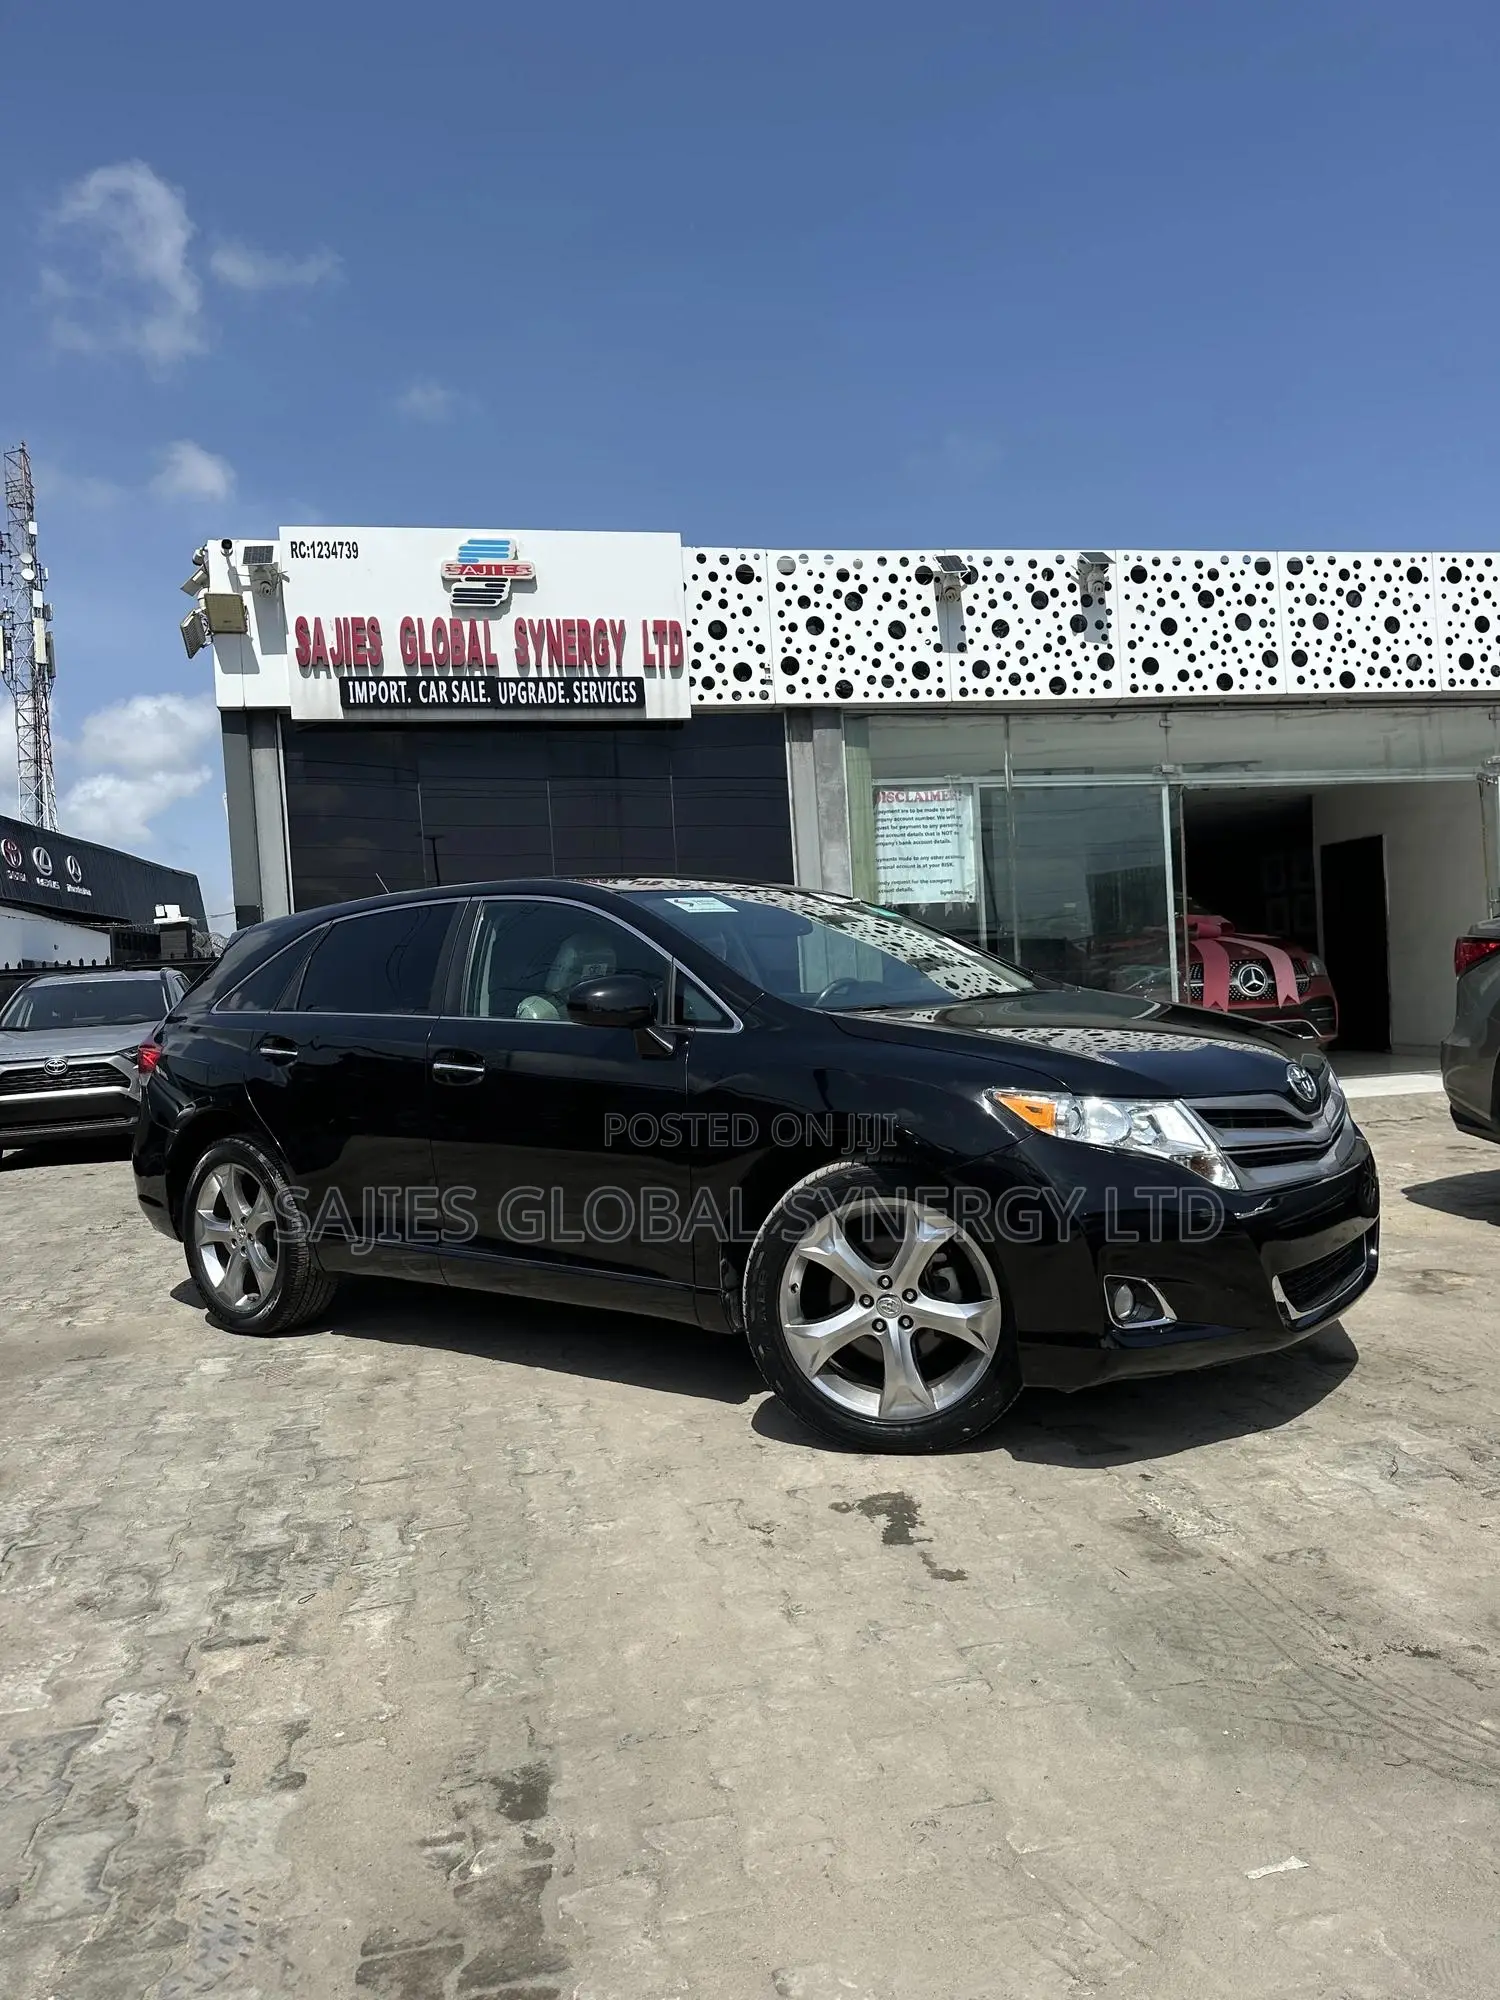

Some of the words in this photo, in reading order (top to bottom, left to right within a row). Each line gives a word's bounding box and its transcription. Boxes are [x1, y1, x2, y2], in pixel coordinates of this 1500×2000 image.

[290, 541, 359, 559] RC:1234739
[445, 564, 532, 576] SAJIES
[295, 616, 383, 667] SAJIES
[400, 616, 498, 667] GLOBAL
[514, 617, 626, 667] SYNERGY
[642, 619, 684, 667] LTD
[348, 680, 411, 704] IMPORT.
[419, 680, 449, 703] CAR
[452, 680, 491, 704] SALE.
[498, 681, 570, 704] UPGRADE.
[573, 681, 637, 703] SERVICES
